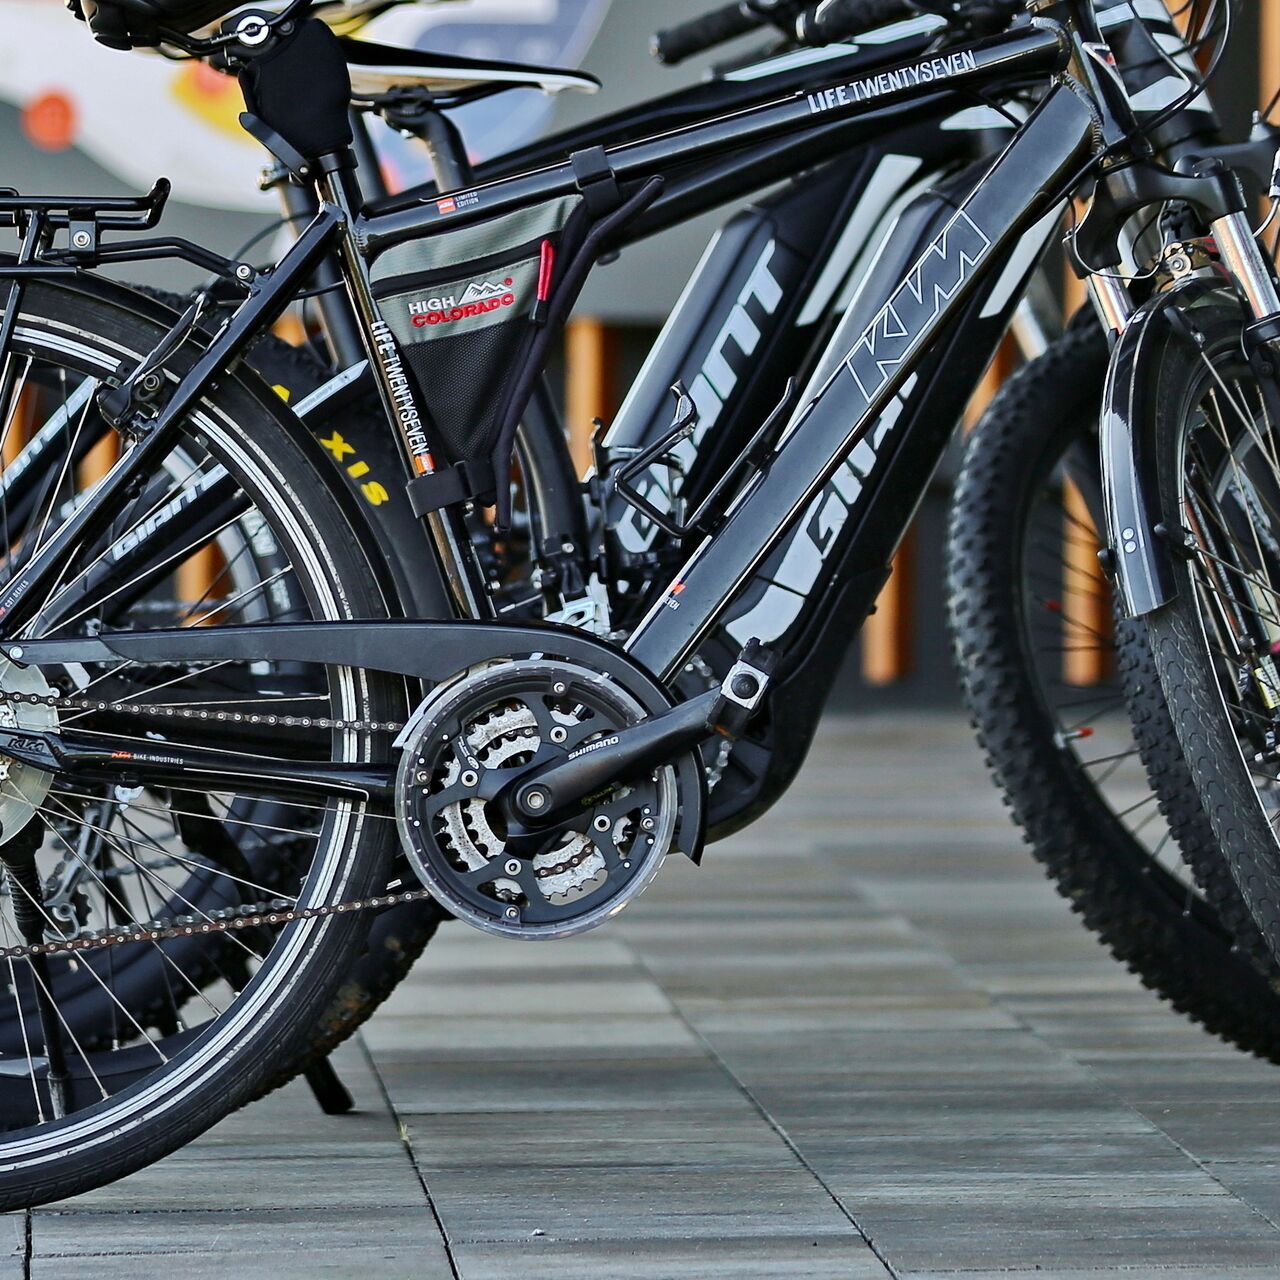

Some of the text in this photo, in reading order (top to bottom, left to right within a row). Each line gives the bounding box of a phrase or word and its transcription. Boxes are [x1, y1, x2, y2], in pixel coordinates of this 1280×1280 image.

[807, 50, 977, 114] LIFE TWENTYSEVEN
[408, 295, 457, 315] HIGH
[411, 293, 515, 327] COLORADO
[846, 209, 991, 404] KTM
[371, 320, 430, 456] LIFE TWENTYSEVEN
[568, 736, 619, 760] SHIMANO
